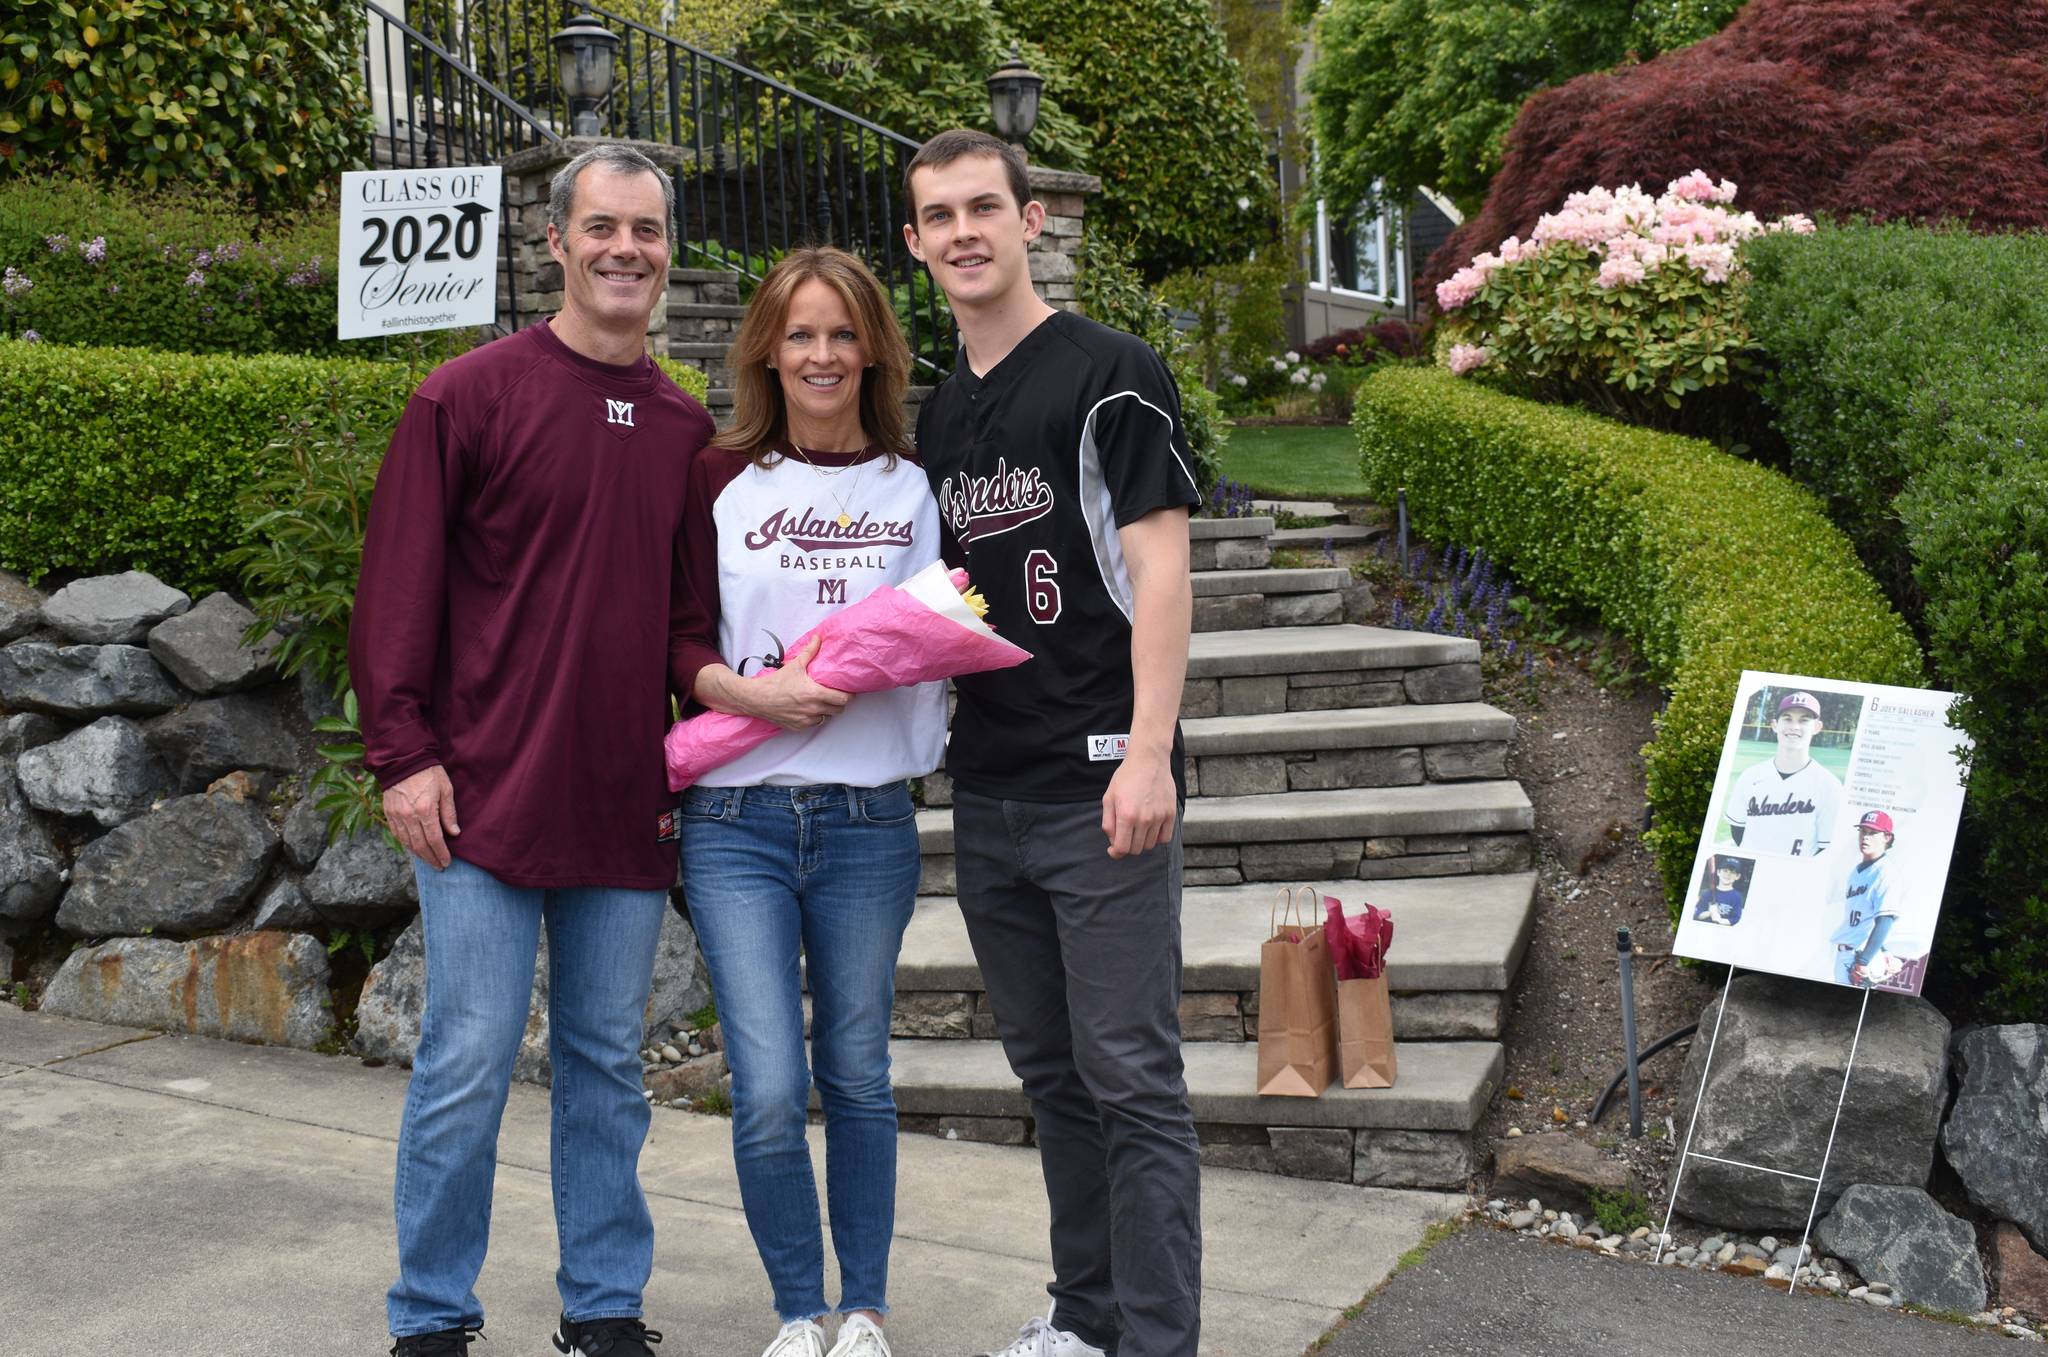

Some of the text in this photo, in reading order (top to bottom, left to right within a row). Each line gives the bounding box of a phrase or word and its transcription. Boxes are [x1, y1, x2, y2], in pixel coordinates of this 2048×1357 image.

[362, 174, 484, 203] CLASS OF
[359, 213, 484, 267] 2020
[360, 254, 484, 321] Senior
[381, 312, 457, 329] #allinthistogether
[744, 506, 914, 552] Islanders
[780, 555, 886, 570] BASEBALL
[1025, 549, 1062, 624] 6
[1870, 697, 1880, 712] 6
[1747, 792, 1815, 816] Islanders
